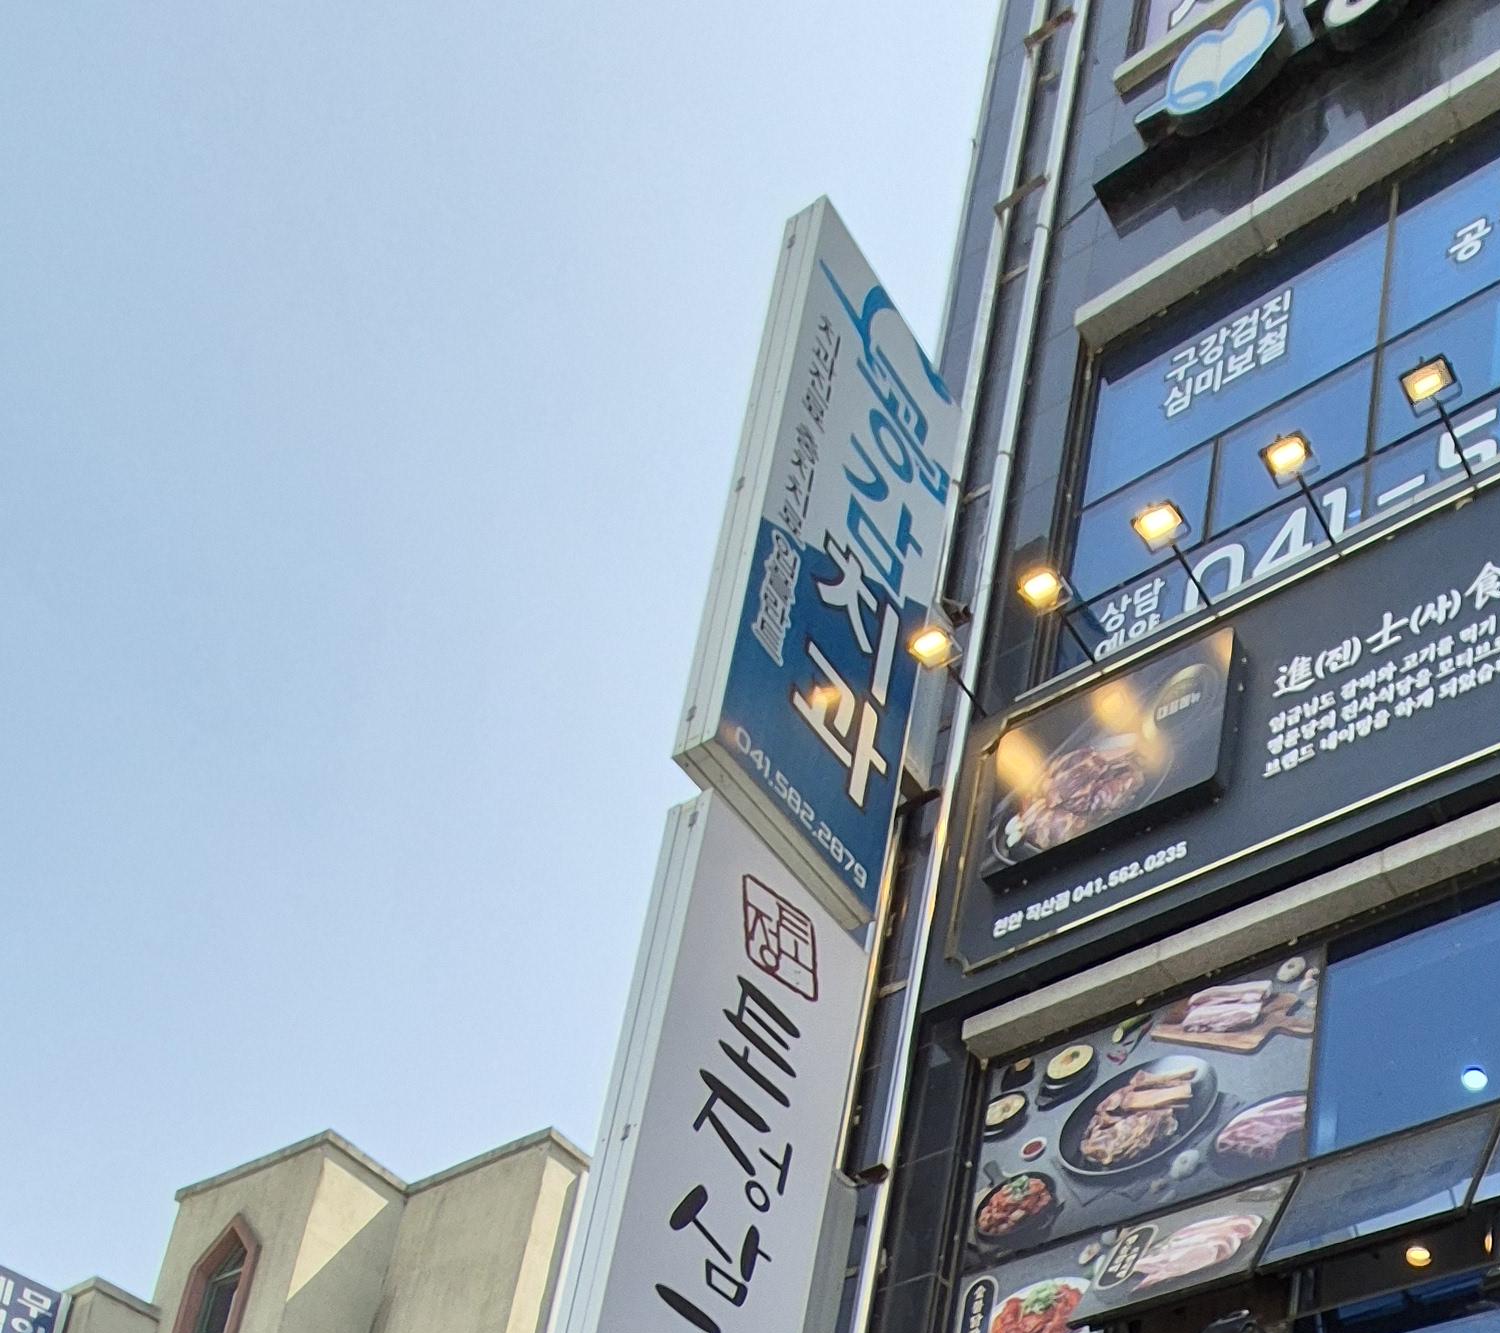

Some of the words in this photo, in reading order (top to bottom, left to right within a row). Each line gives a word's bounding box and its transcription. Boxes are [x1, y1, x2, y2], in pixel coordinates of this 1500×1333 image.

[1162, 328, 1291, 419] 심미보철
[1169, 287, 1296, 384] 구강검진
[790, 345, 951, 810] 공감치과
[1100, 576, 1166, 632] 상담
[733, 725, 870, 890] 041.582.2879
